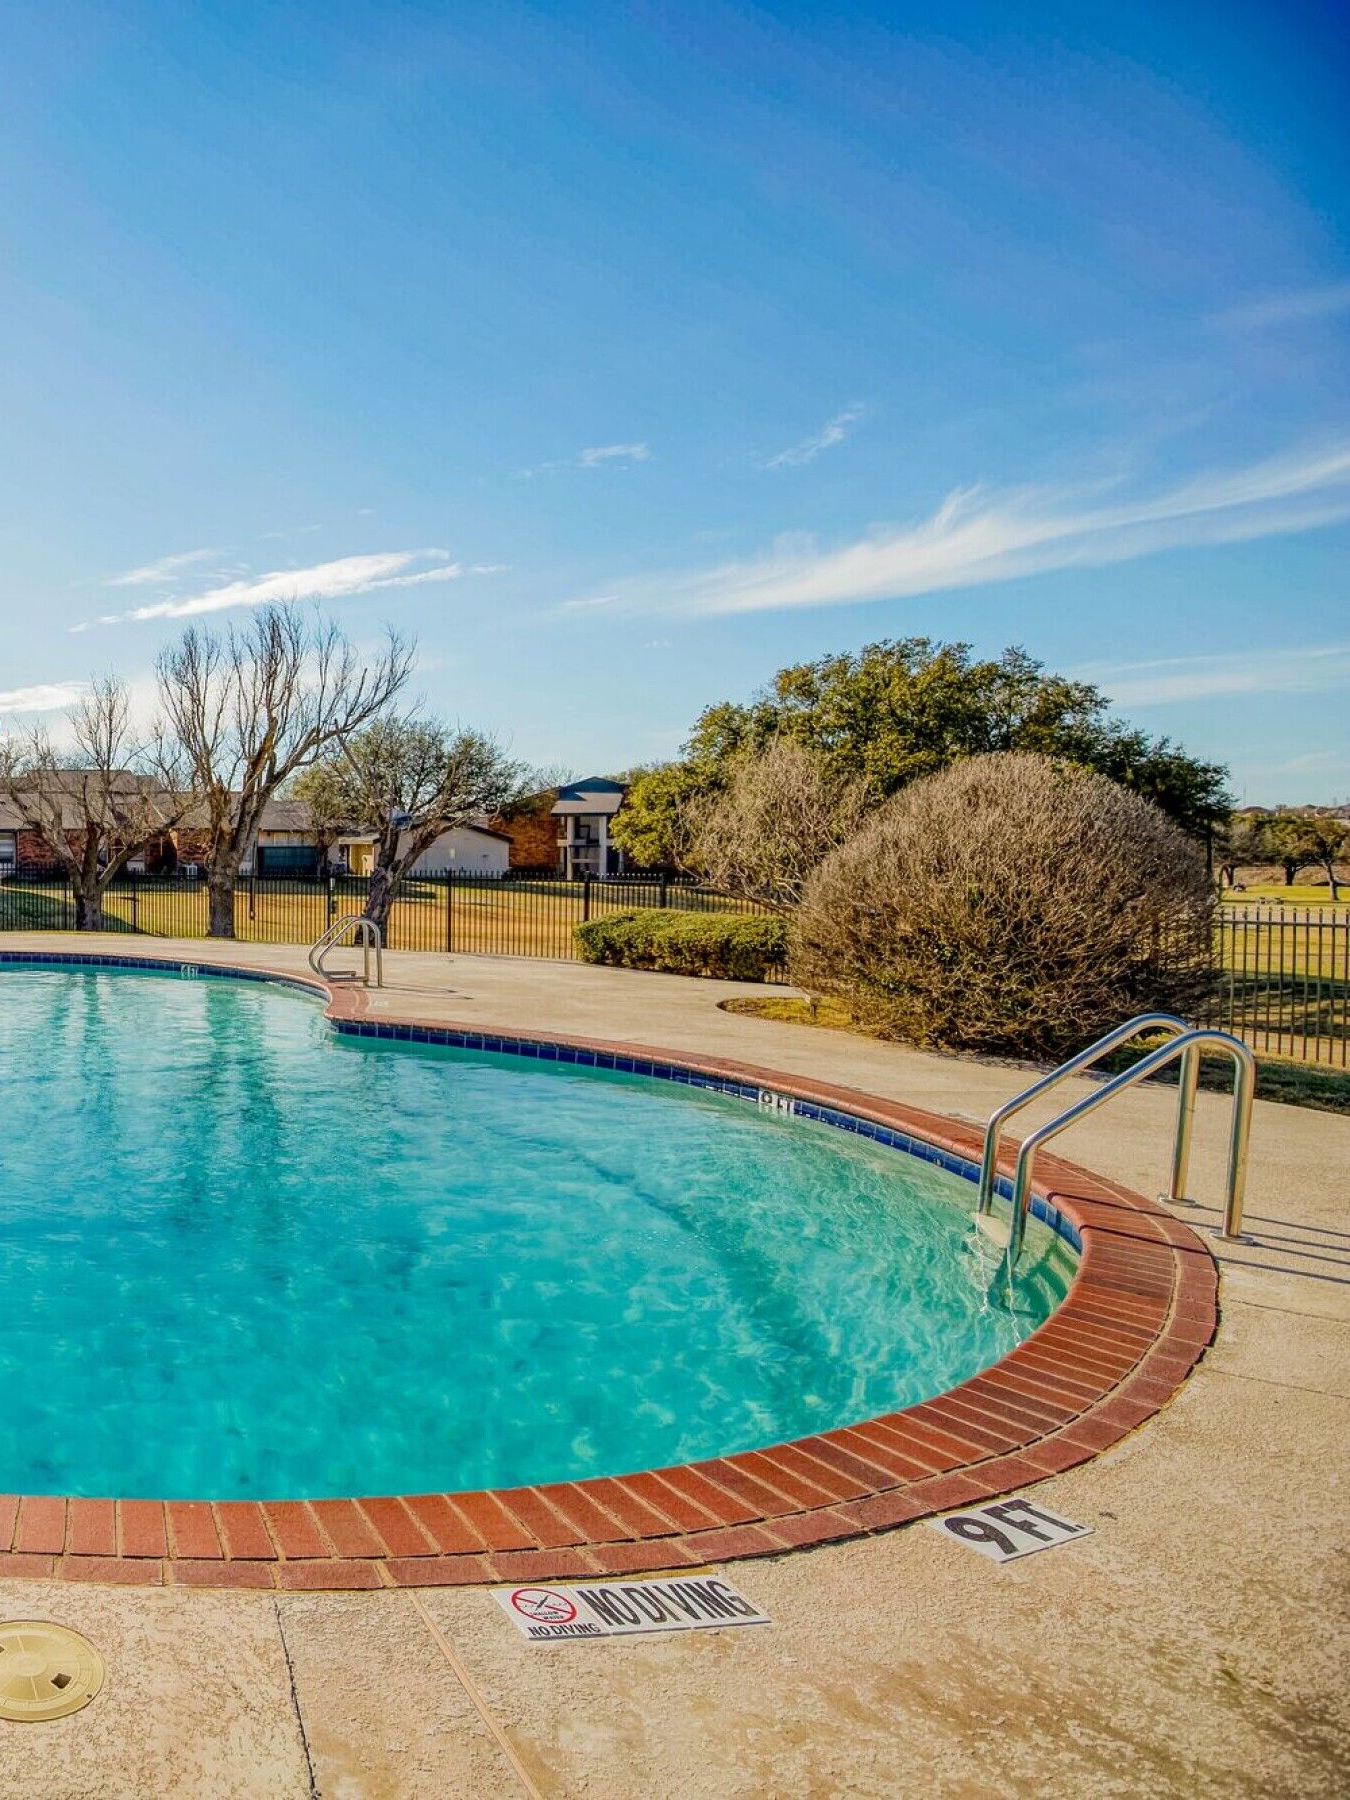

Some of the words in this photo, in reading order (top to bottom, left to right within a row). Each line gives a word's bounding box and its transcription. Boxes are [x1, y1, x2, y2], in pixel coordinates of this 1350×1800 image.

[945, 1516, 1019, 1555] 9
[576, 1587, 641, 1627] NO
[620, 1580, 760, 1624] DIVING
[528, 1625, 551, 1636] NO
[550, 1622, 602, 1635] DIVING
